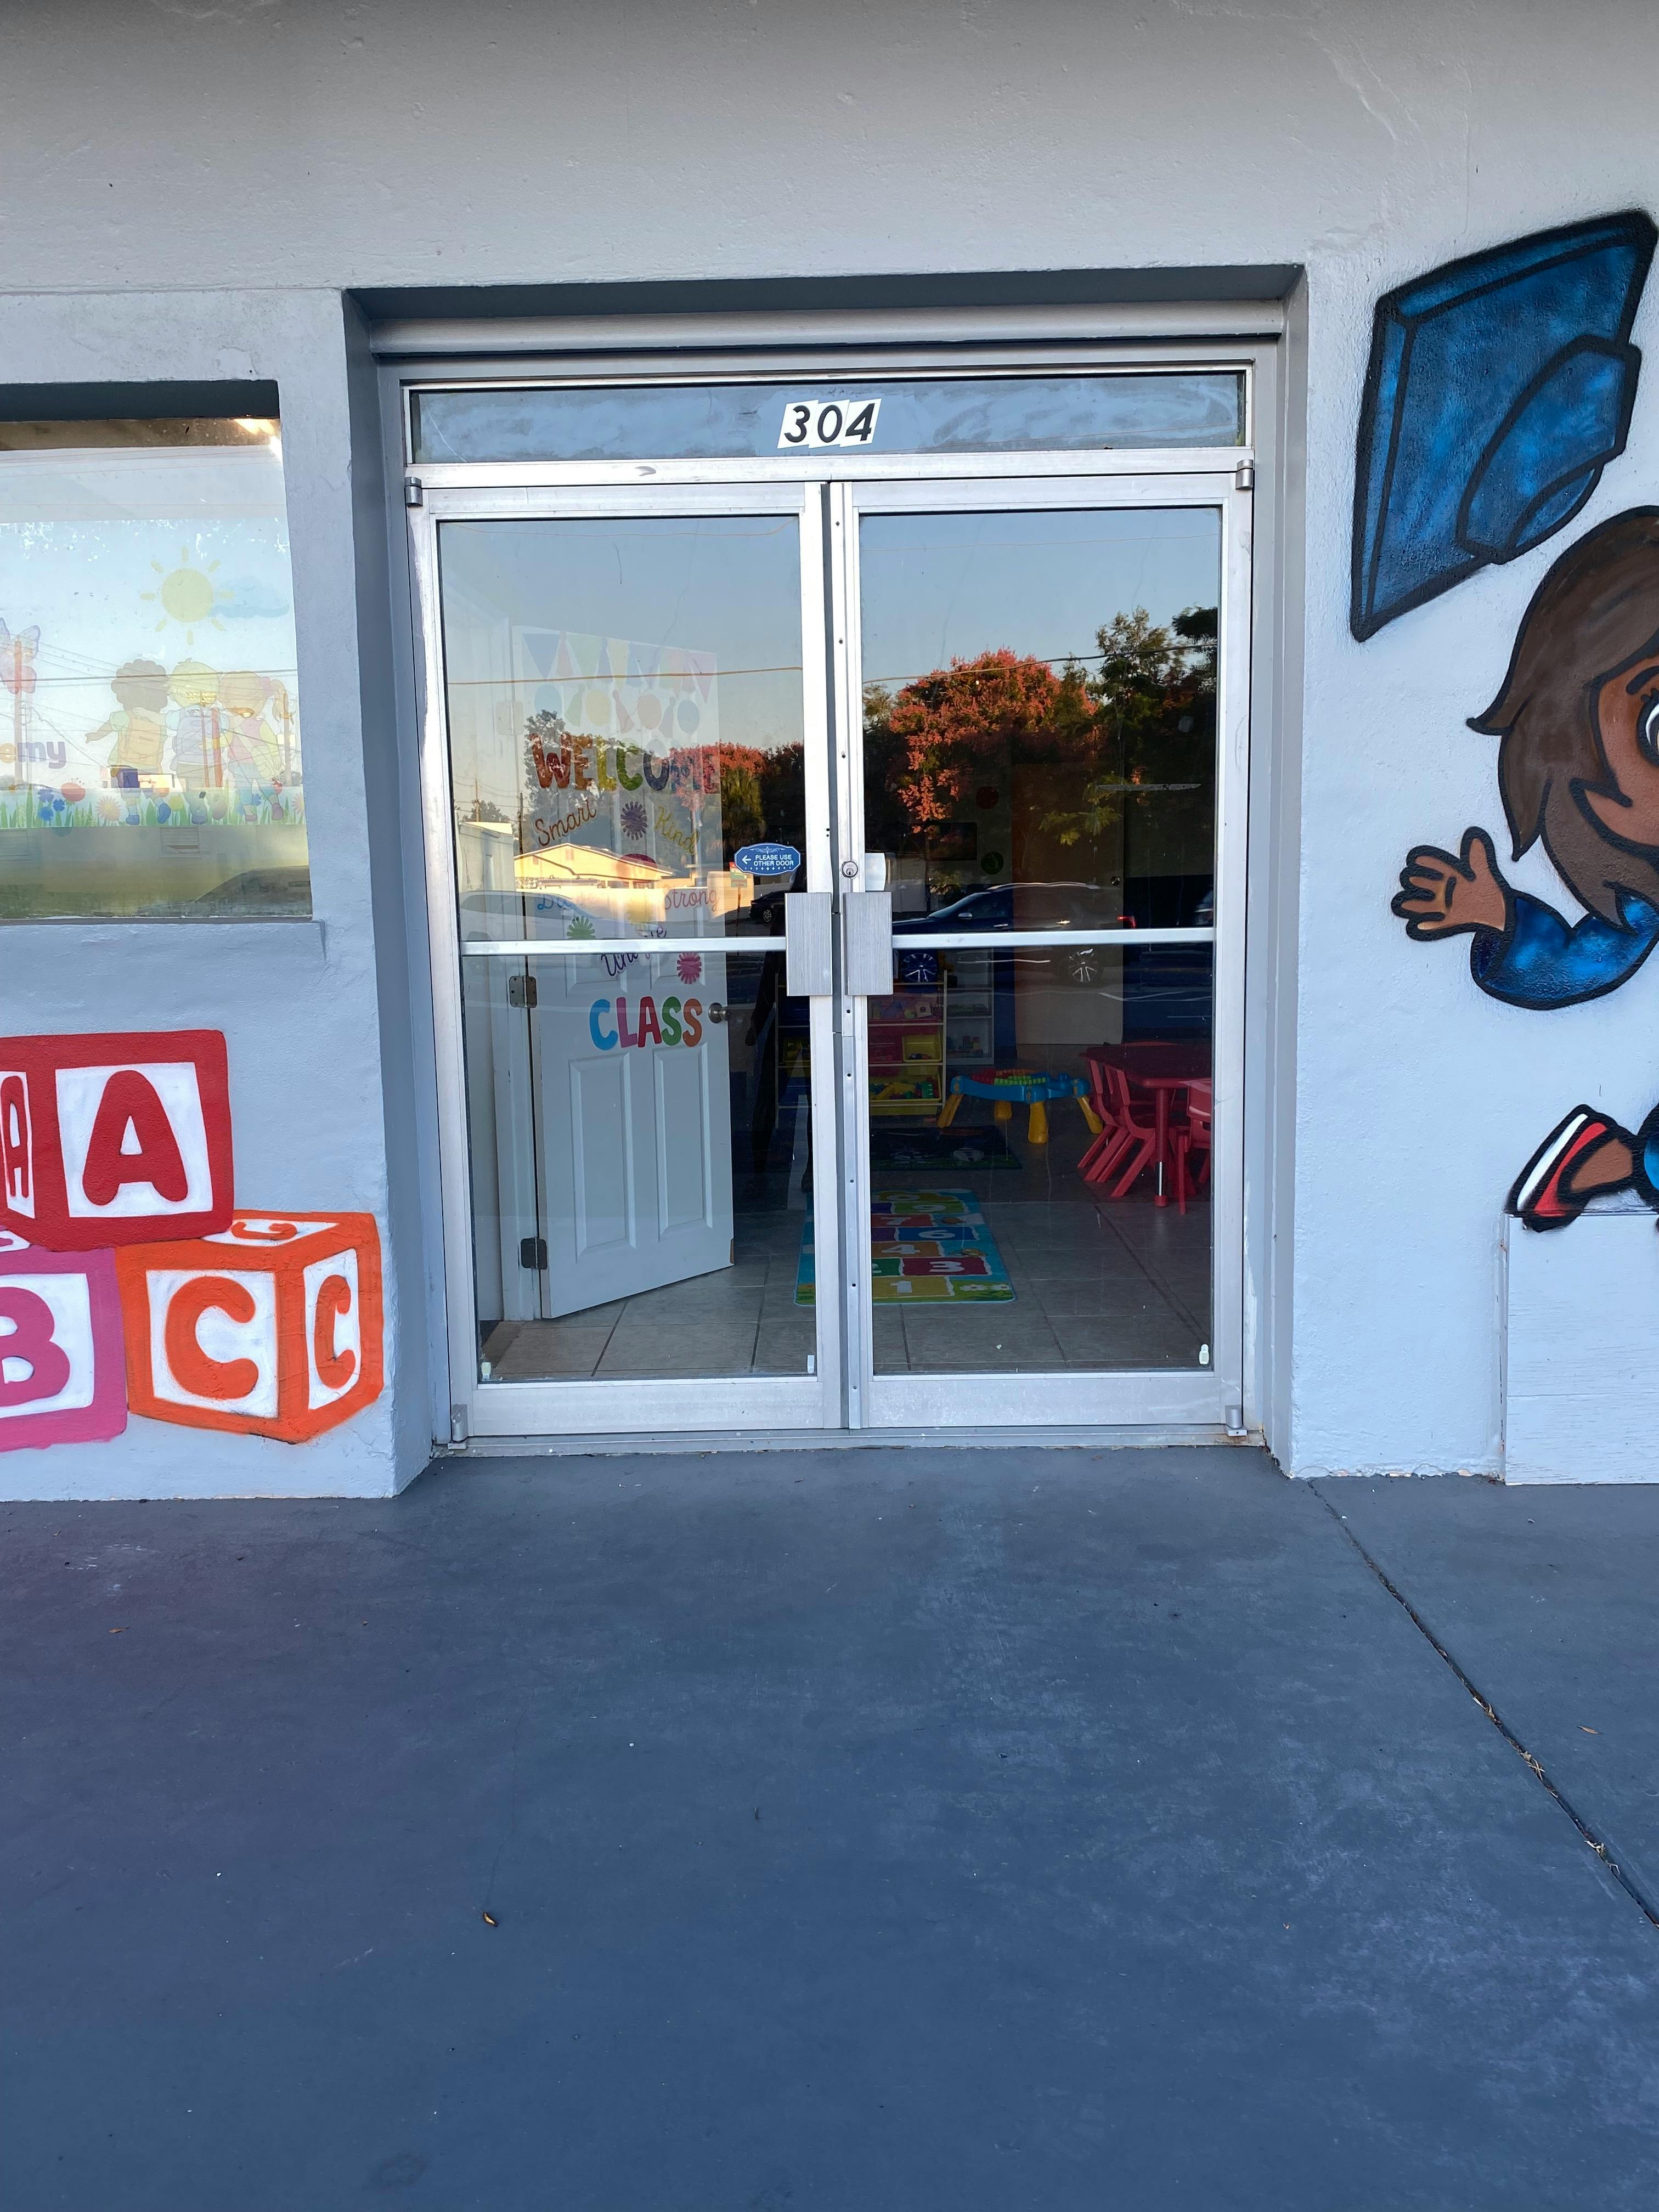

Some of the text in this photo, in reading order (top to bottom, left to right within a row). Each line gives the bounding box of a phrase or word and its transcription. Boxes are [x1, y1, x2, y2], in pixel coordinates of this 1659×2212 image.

[783, 402, 876, 443] 304
[534, 799, 597, 847] Smart
[653, 805, 699, 855] Kind
[663, 884, 719, 912] Strong
[589, 996, 703, 1051] CLASS
[82, 1070, 188, 1206] A
[881, 1244, 921, 1255] 4
[918, 1229, 956, 1239] 6
[890, 1280, 913, 1293] 1
[929, 1261, 965, 1272] 3
[0, 1286, 70, 1407] B
[165, 1276, 259, 1400] C
[314, 1274, 356, 1389] C
